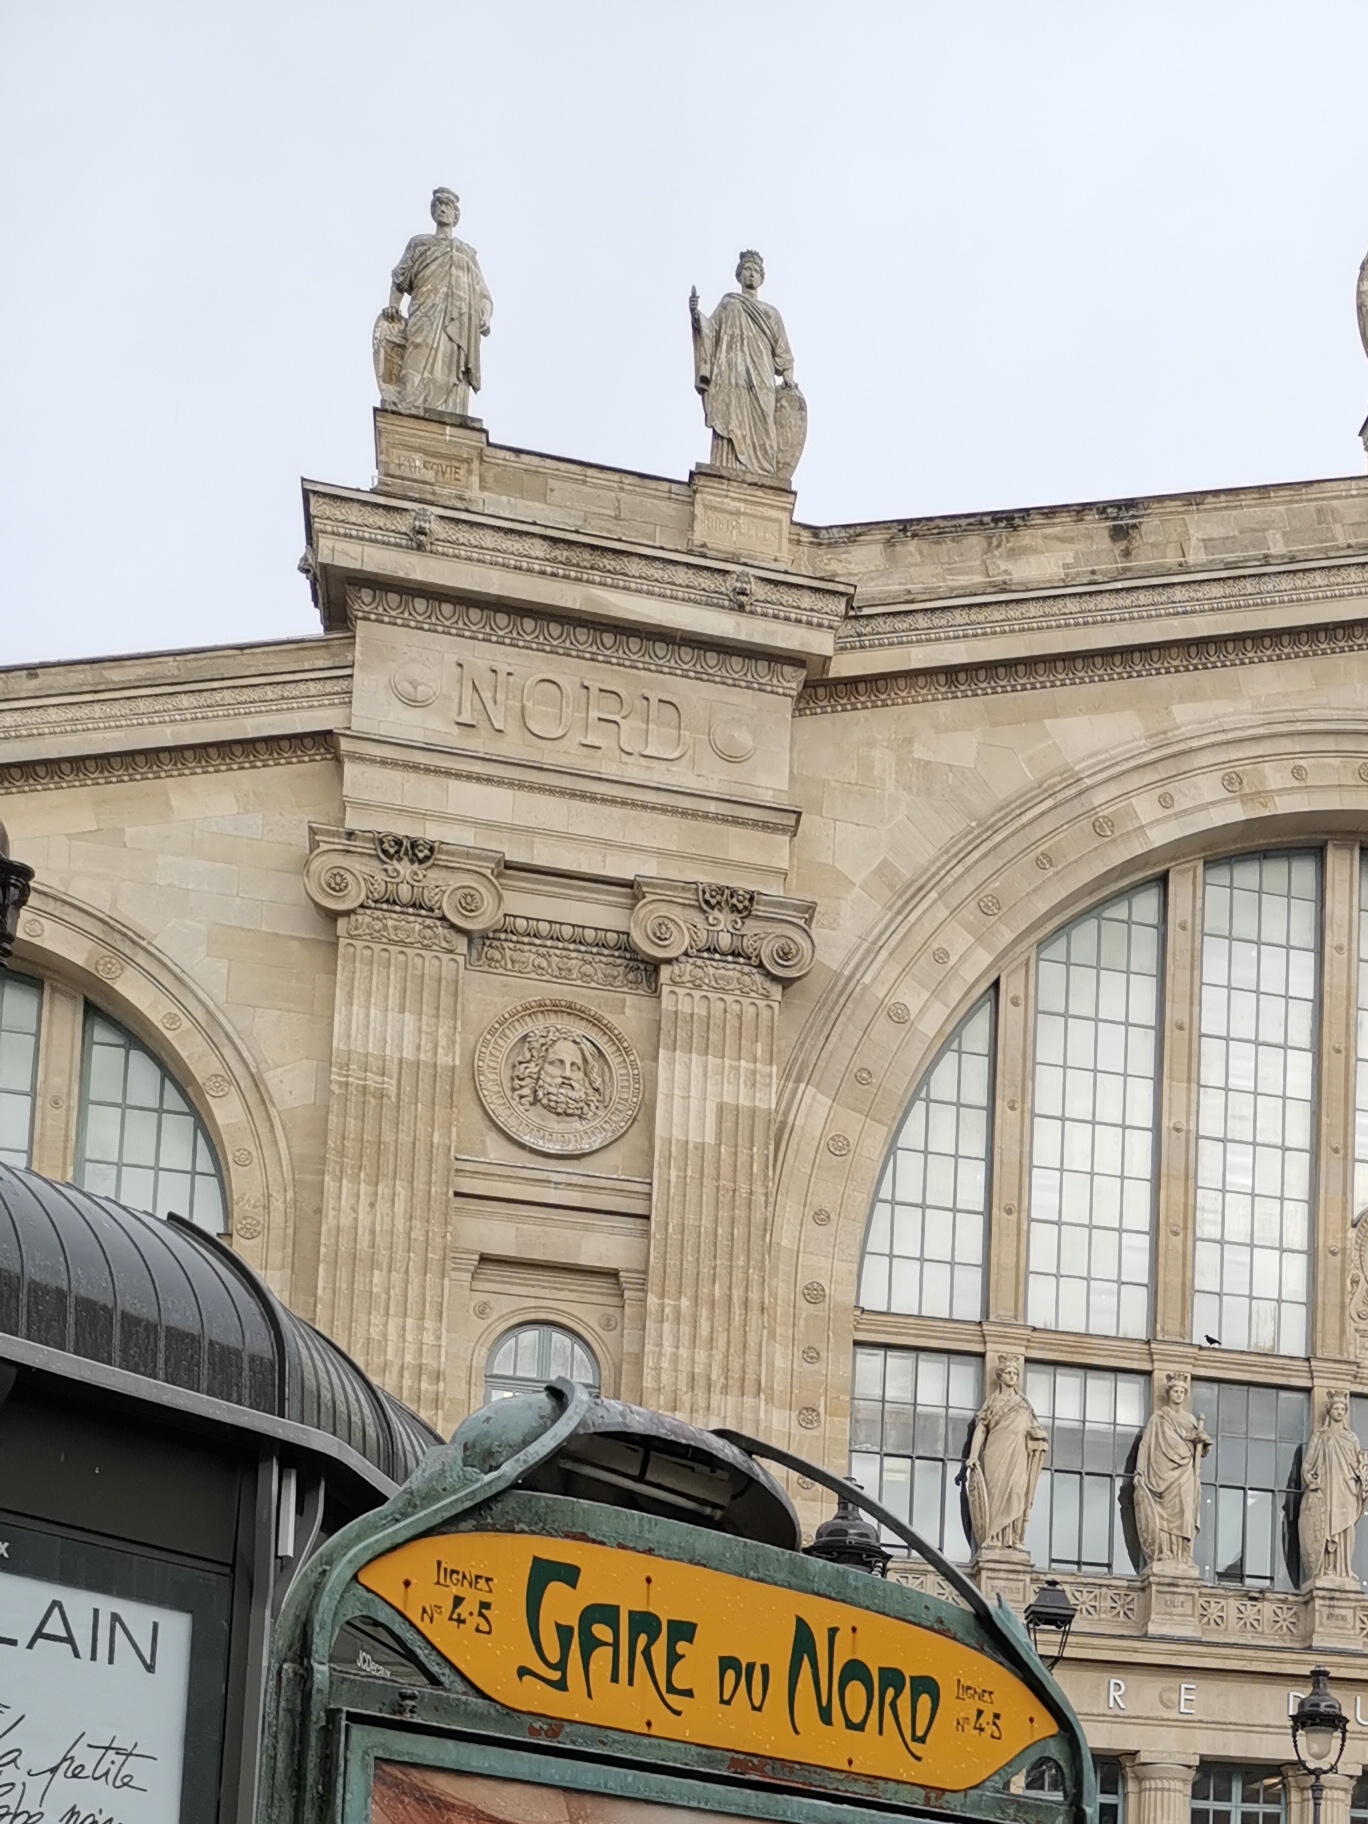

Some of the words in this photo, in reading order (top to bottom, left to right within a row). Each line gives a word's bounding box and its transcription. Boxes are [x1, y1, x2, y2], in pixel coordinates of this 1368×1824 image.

[454, 658, 690, 761] NORD
[433, 1559, 494, 1594] LIGNES
[27, 1731, 158, 1808] petite
